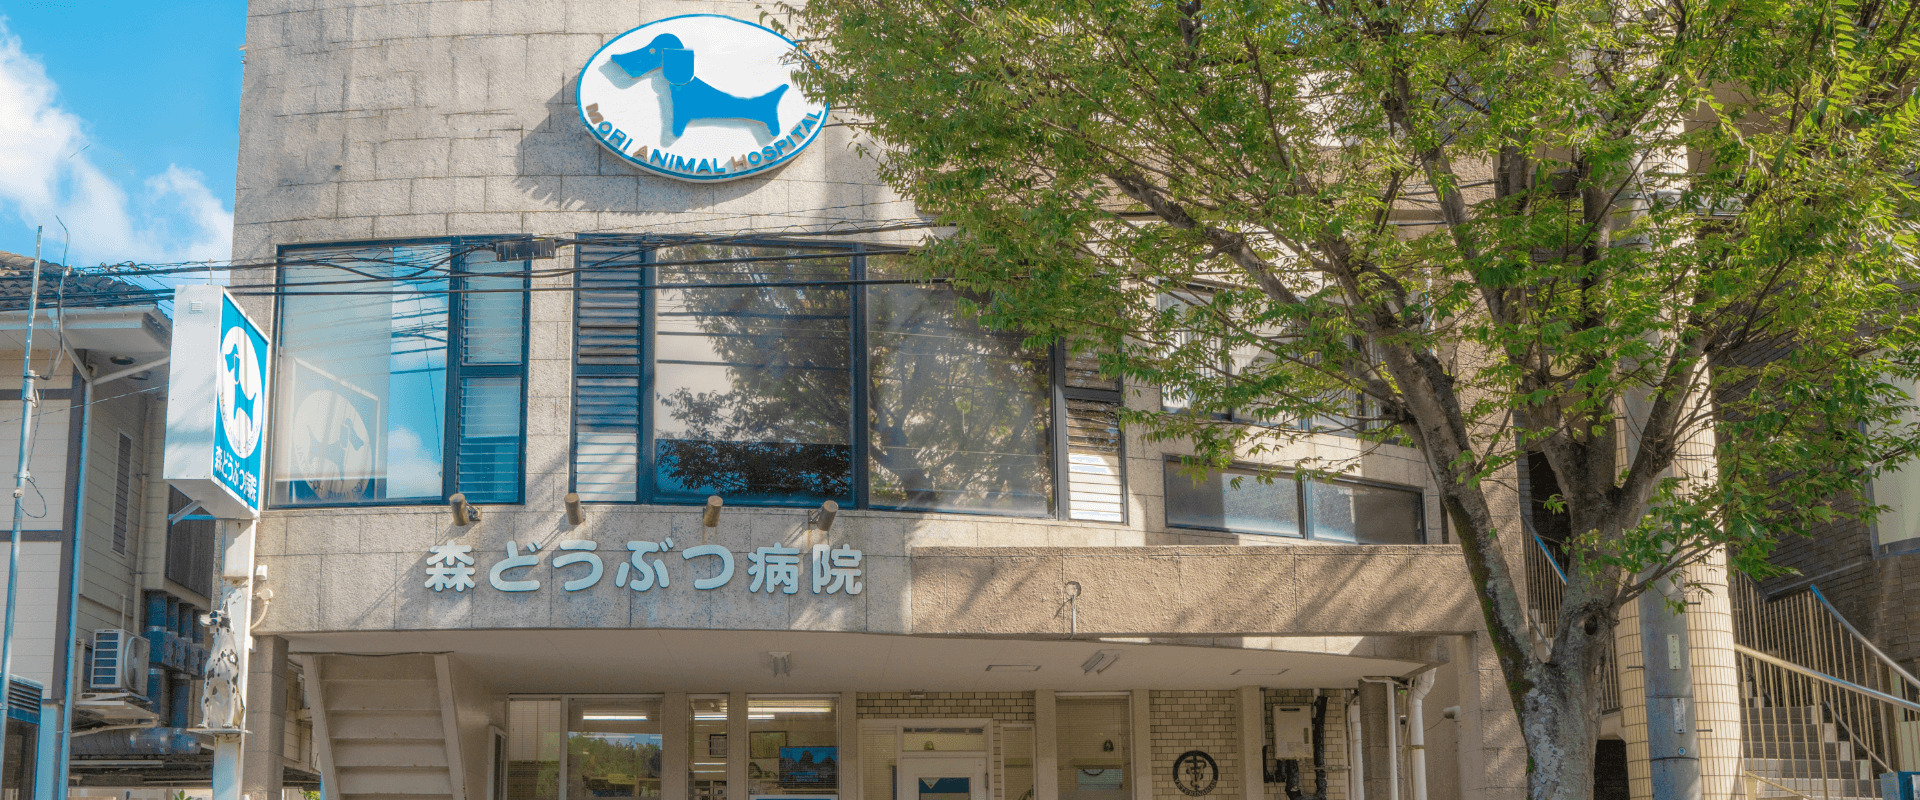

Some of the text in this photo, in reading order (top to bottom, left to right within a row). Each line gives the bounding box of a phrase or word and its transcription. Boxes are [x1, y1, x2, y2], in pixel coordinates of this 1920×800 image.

[586, 103, 823, 174] MORI ANIMAL HOSPITAL
[214, 445, 257, 502] 森どうぶつ病院
[424, 539, 864, 595] 森どうぶつ病院
